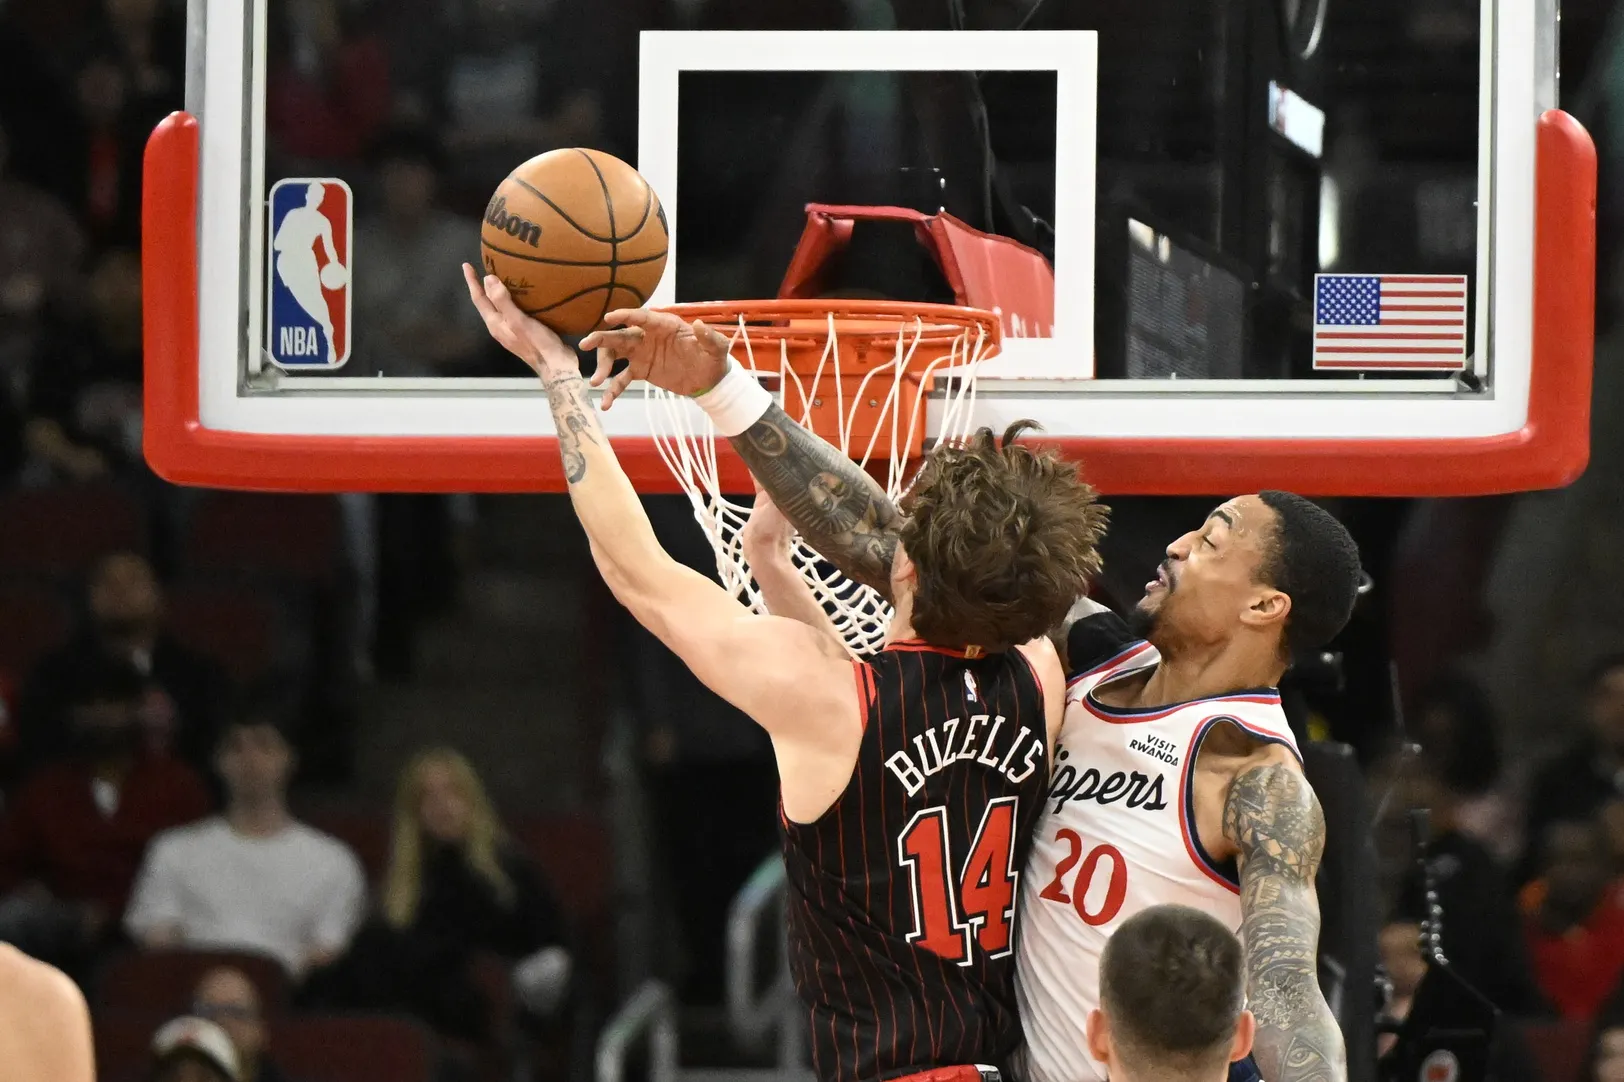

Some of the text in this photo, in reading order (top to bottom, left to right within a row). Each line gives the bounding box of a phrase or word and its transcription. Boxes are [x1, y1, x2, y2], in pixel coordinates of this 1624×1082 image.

[483, 195, 542, 248] ilson
[280, 326, 318, 357] NBA
[885, 714, 1044, 798] BUZELIS
[1129, 739, 1179, 767] RWANDA
[1147, 734, 1177, 753] VISIT
[1047, 744, 1168, 814] ippers
[897, 795, 1019, 967] 14
[1039, 828, 1128, 926] 20
